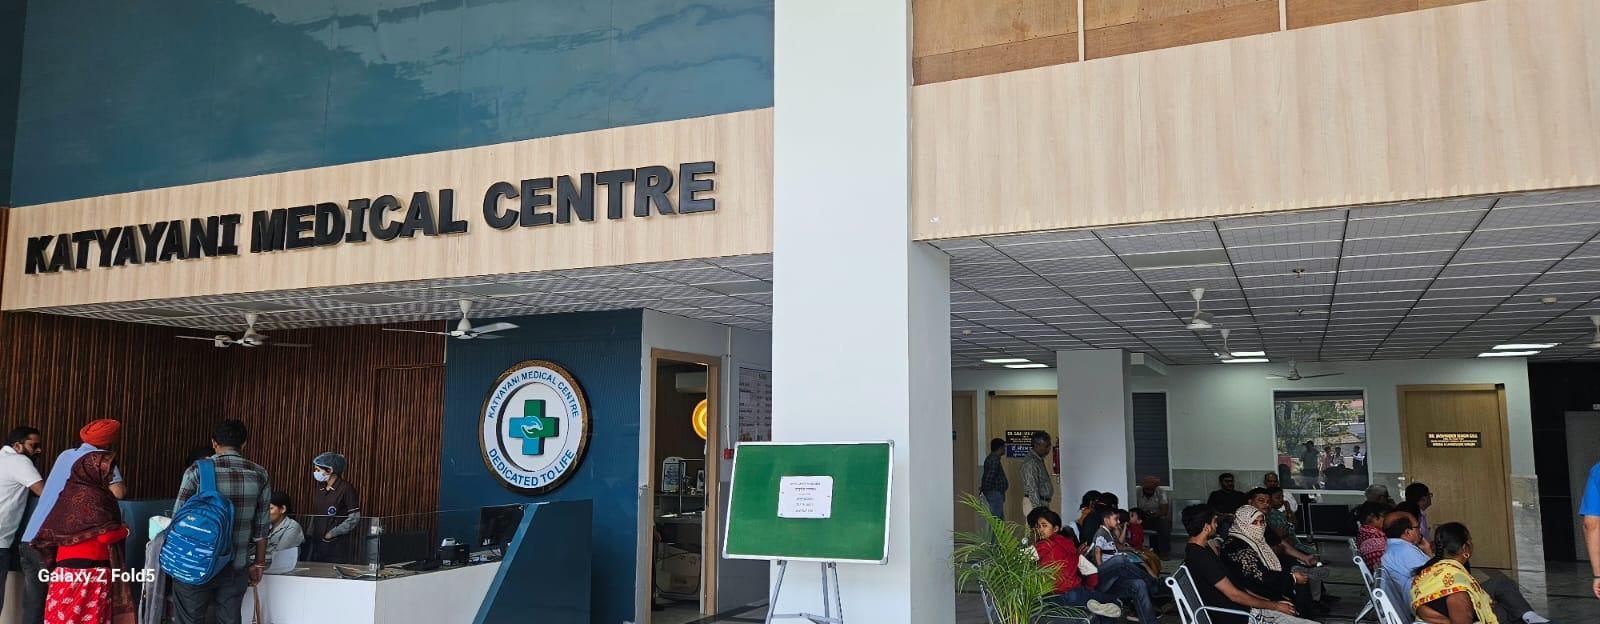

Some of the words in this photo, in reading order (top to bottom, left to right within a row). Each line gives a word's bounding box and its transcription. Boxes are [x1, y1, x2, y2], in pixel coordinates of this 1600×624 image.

[24, 213, 241, 275] KATYAYANI
[250, 188, 468, 253] MEDICAL
[482, 160, 716, 230] CENTRE
[488, 375, 520, 418] KATYAYANI
[521, 370, 557, 385] MEDICAL
[557, 381, 579, 418] CENTRE
[488, 448, 538, 486] DEDICATED
[541, 470, 555, 482] TO
[555, 449, 575, 474] LIFE
